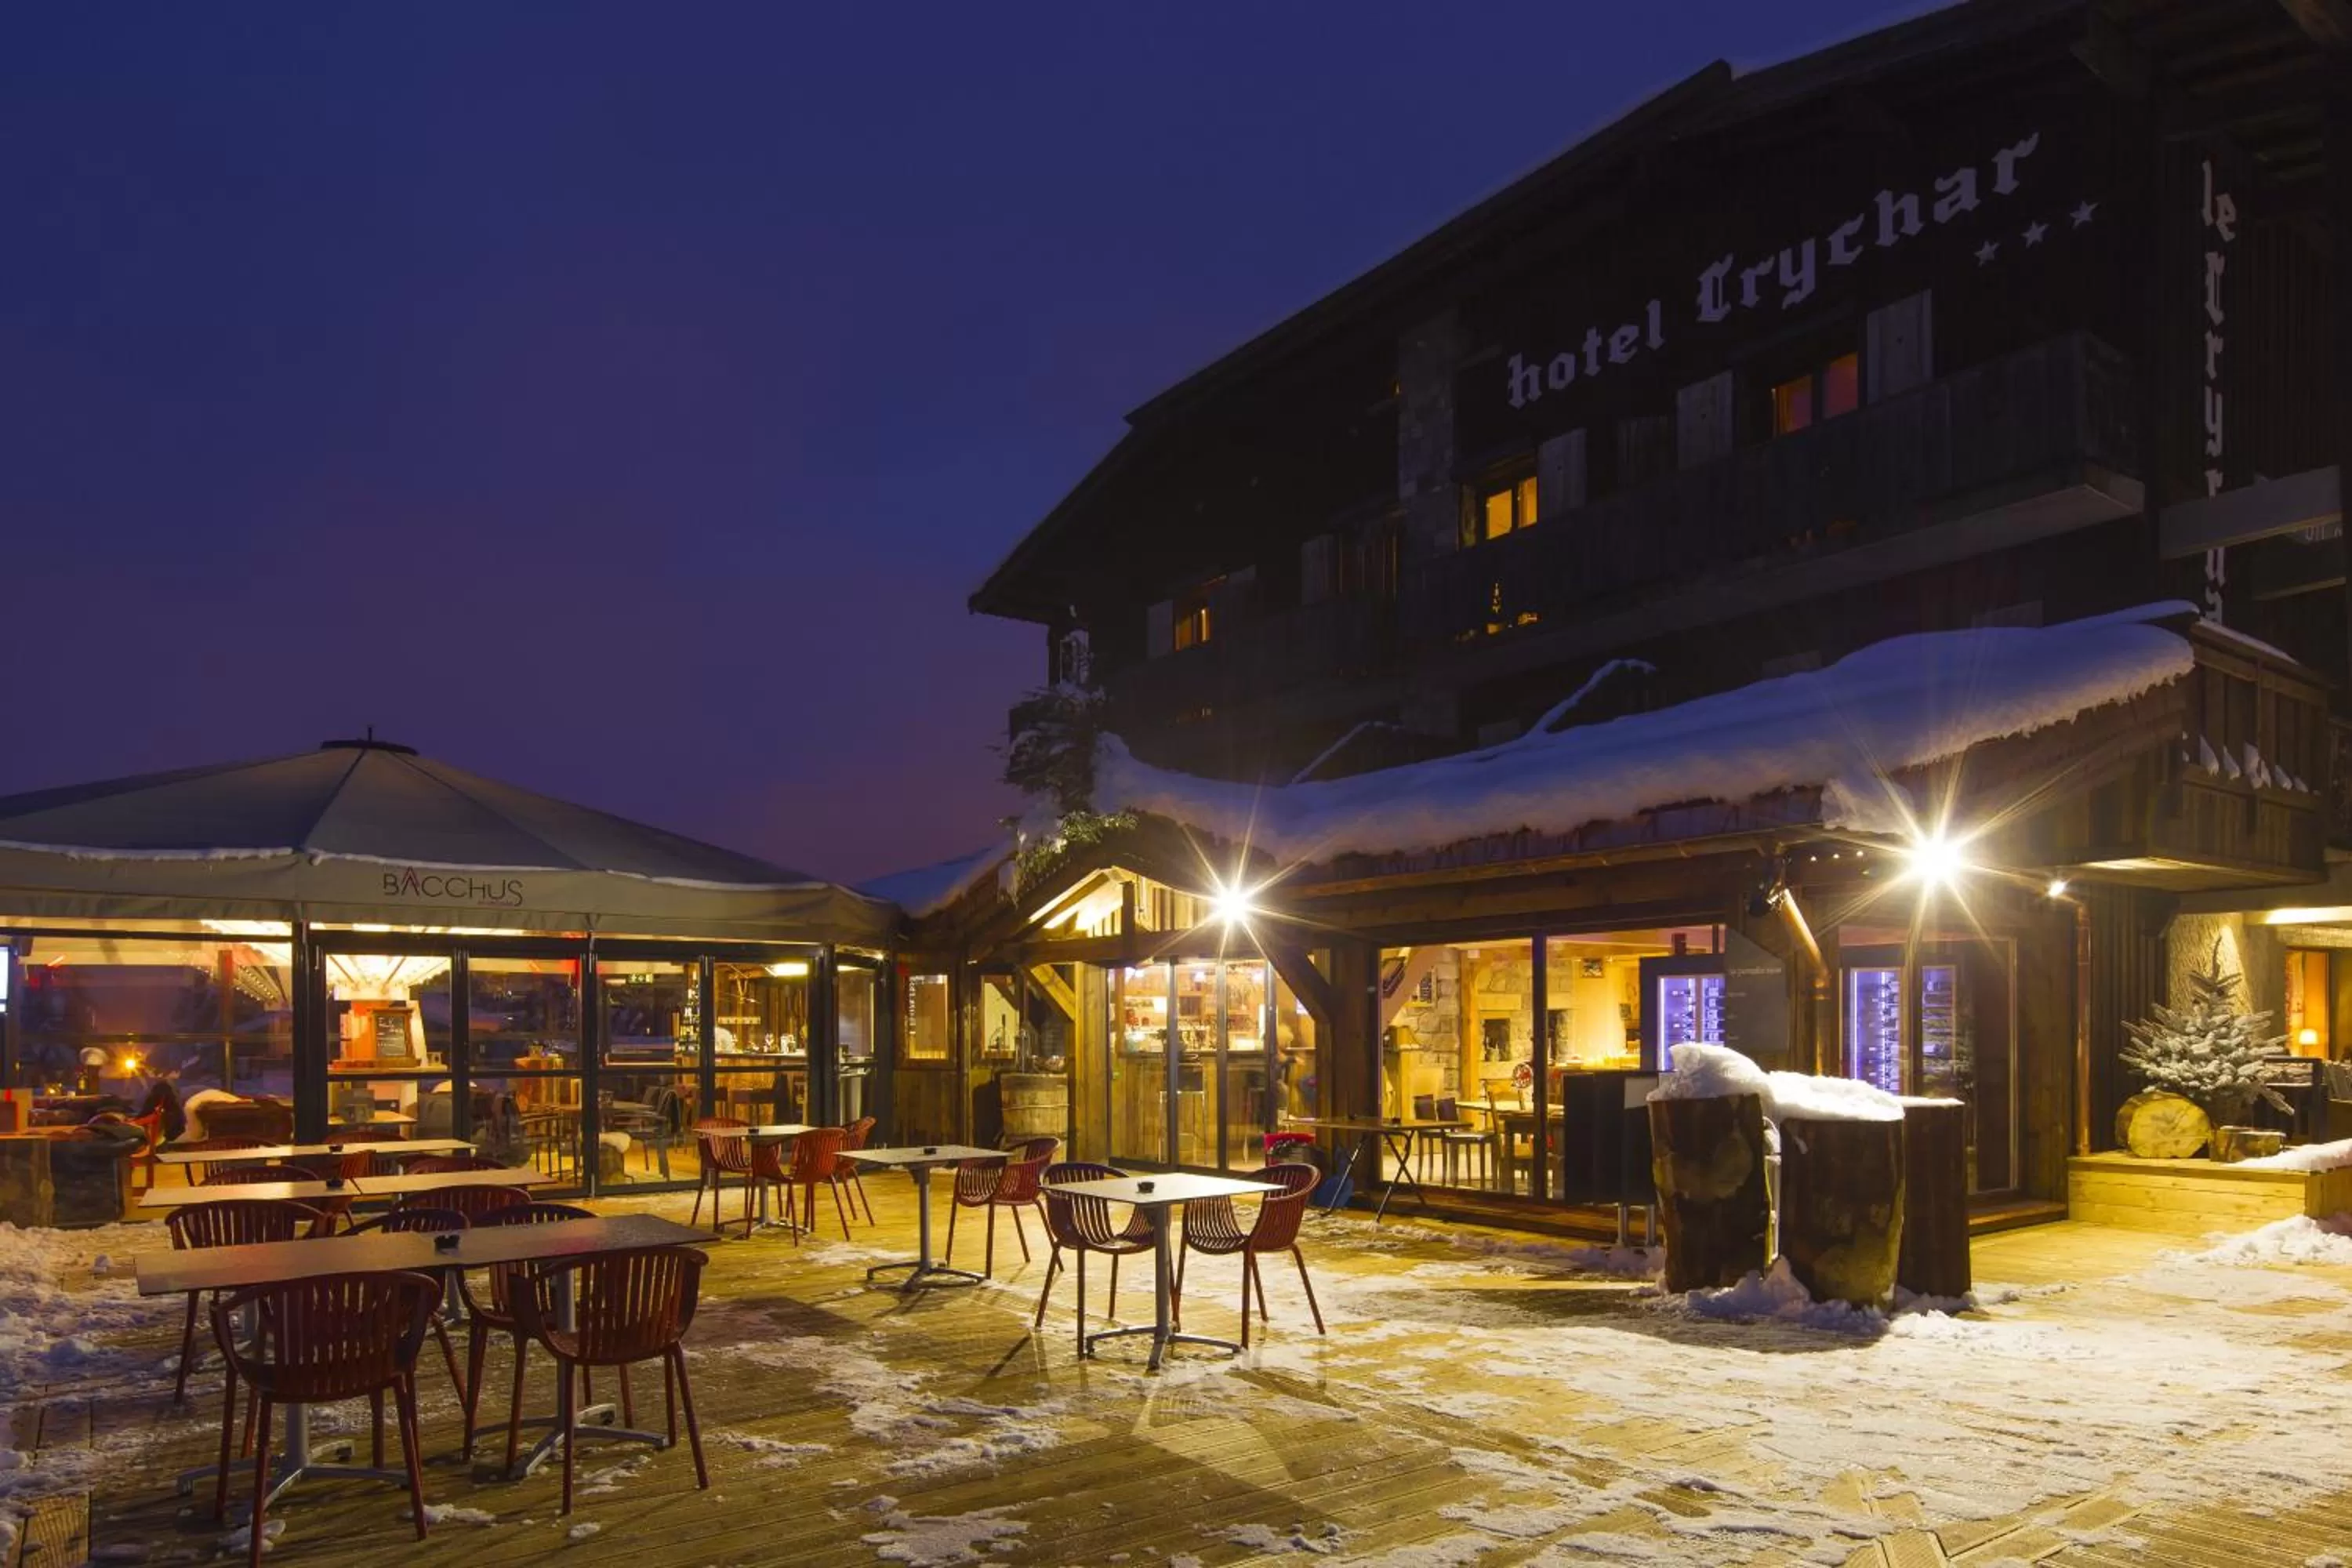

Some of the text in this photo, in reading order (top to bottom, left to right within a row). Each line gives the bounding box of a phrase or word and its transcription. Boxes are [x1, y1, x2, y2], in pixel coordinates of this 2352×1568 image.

[1507, 132, 2040, 410] hotel Crychar
[383, 866, 523, 907] BACCHUS
